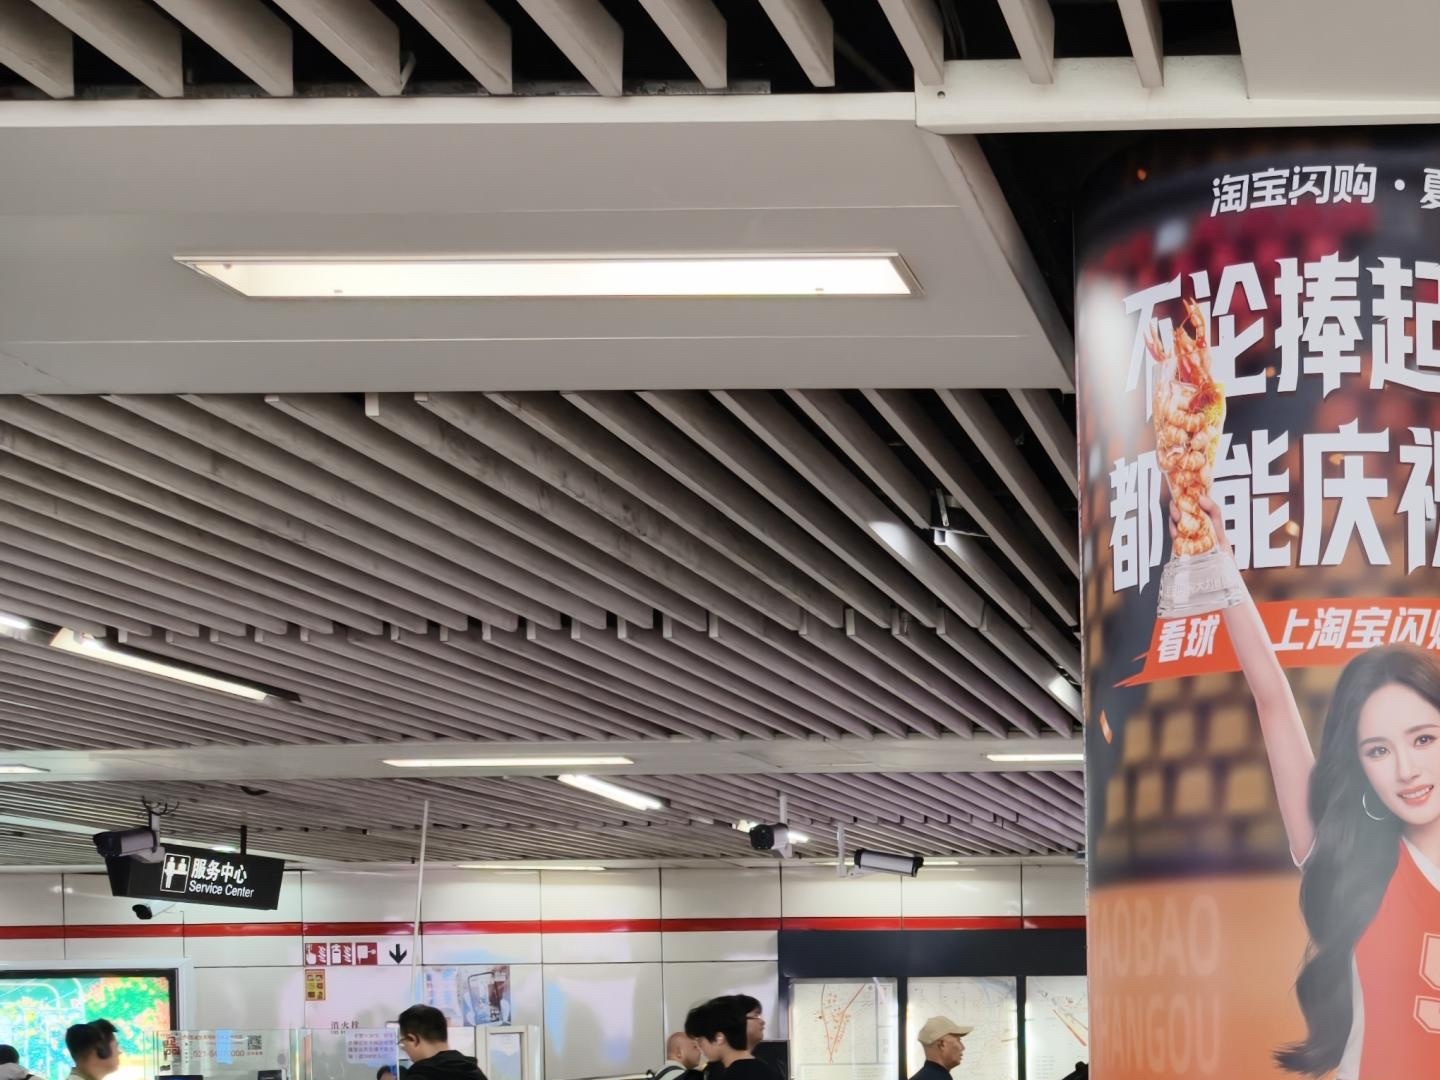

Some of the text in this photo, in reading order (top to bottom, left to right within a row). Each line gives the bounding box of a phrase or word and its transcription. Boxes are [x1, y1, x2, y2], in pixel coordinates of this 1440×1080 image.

[1158, 614, 1220, 663] 看球
[191, 858, 247, 884] 服务中心
[188, 879, 254, 898] Service Center
